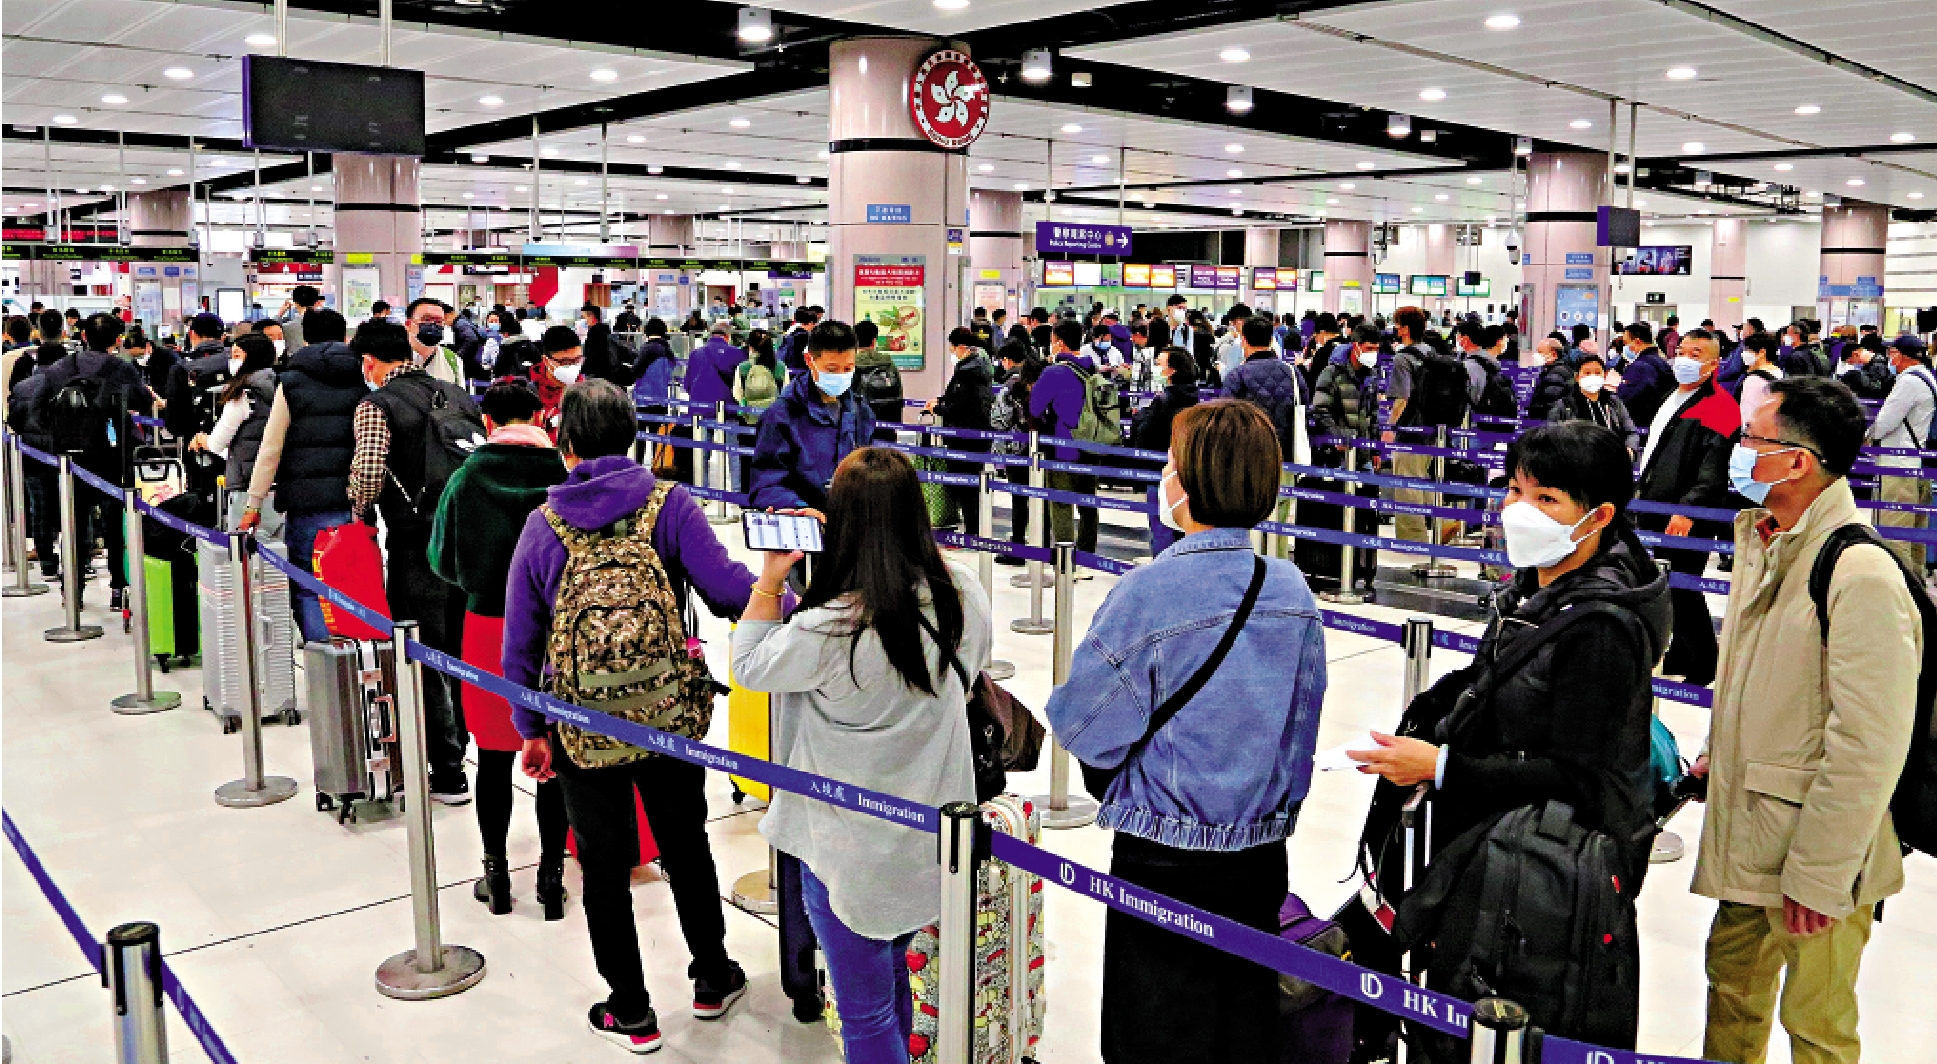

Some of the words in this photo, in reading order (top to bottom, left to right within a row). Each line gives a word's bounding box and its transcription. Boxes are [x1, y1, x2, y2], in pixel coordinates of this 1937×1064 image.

[685, 743, 738, 770] Immigration
[858, 792, 926, 824] Immigration
[1089, 874, 1114, 900] HK
[1119, 886, 1215, 938] Immigration
[1403, 988, 1438, 1019] HK
